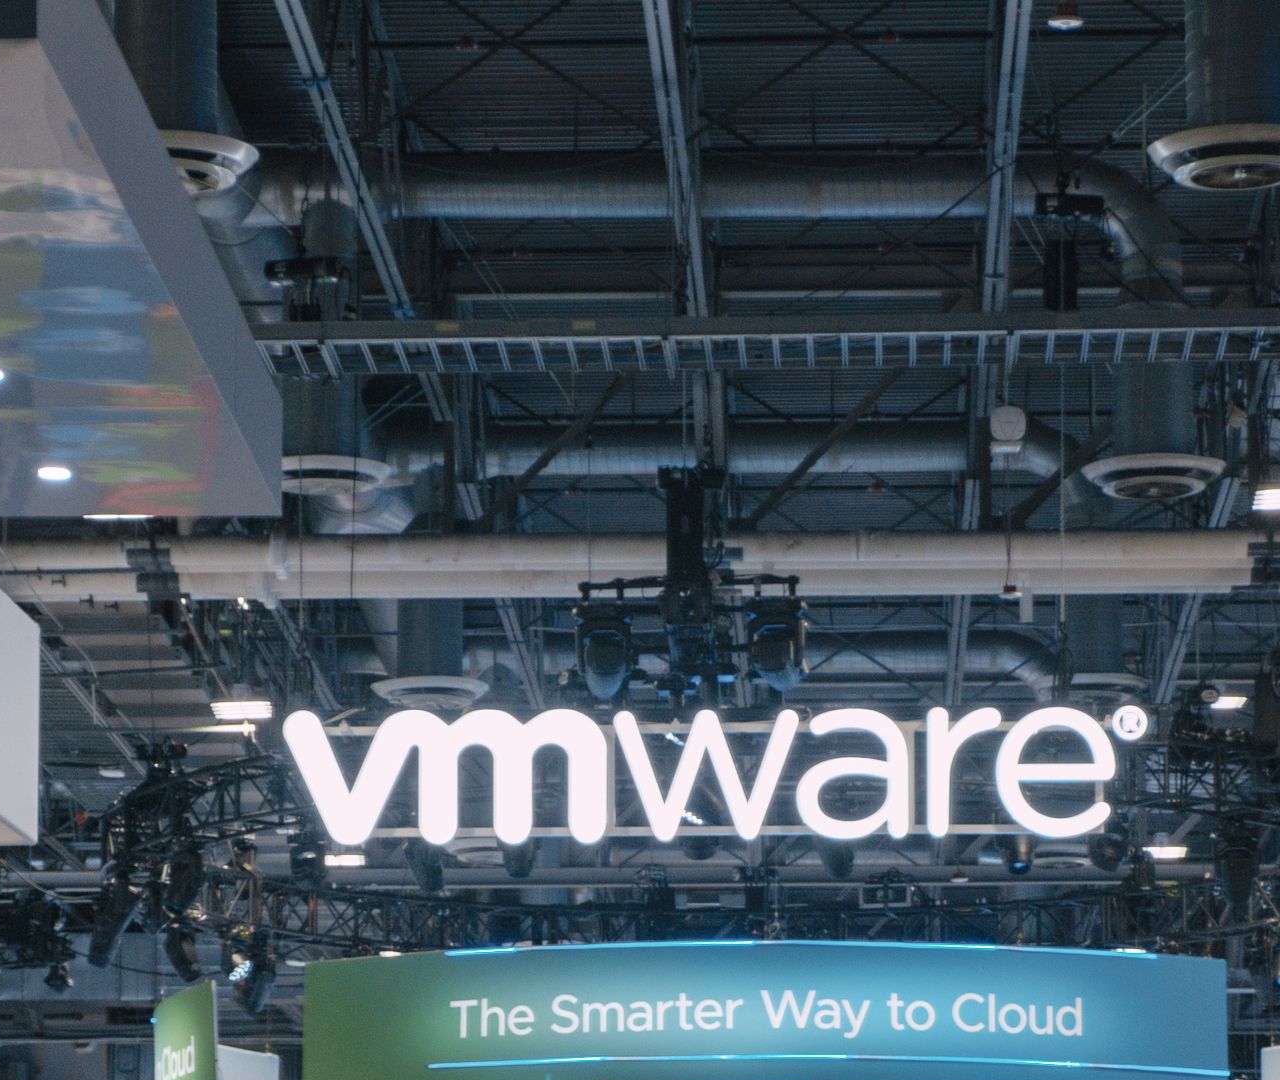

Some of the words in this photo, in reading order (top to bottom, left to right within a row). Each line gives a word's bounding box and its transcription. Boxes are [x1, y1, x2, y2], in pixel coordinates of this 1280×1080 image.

[449, 999, 535, 1039] The
[550, 993, 744, 1035] Smarter
[760, 989, 872, 1039] Way
[886, 992, 937, 1030] to
[951, 992, 1084, 1037] Cloud
